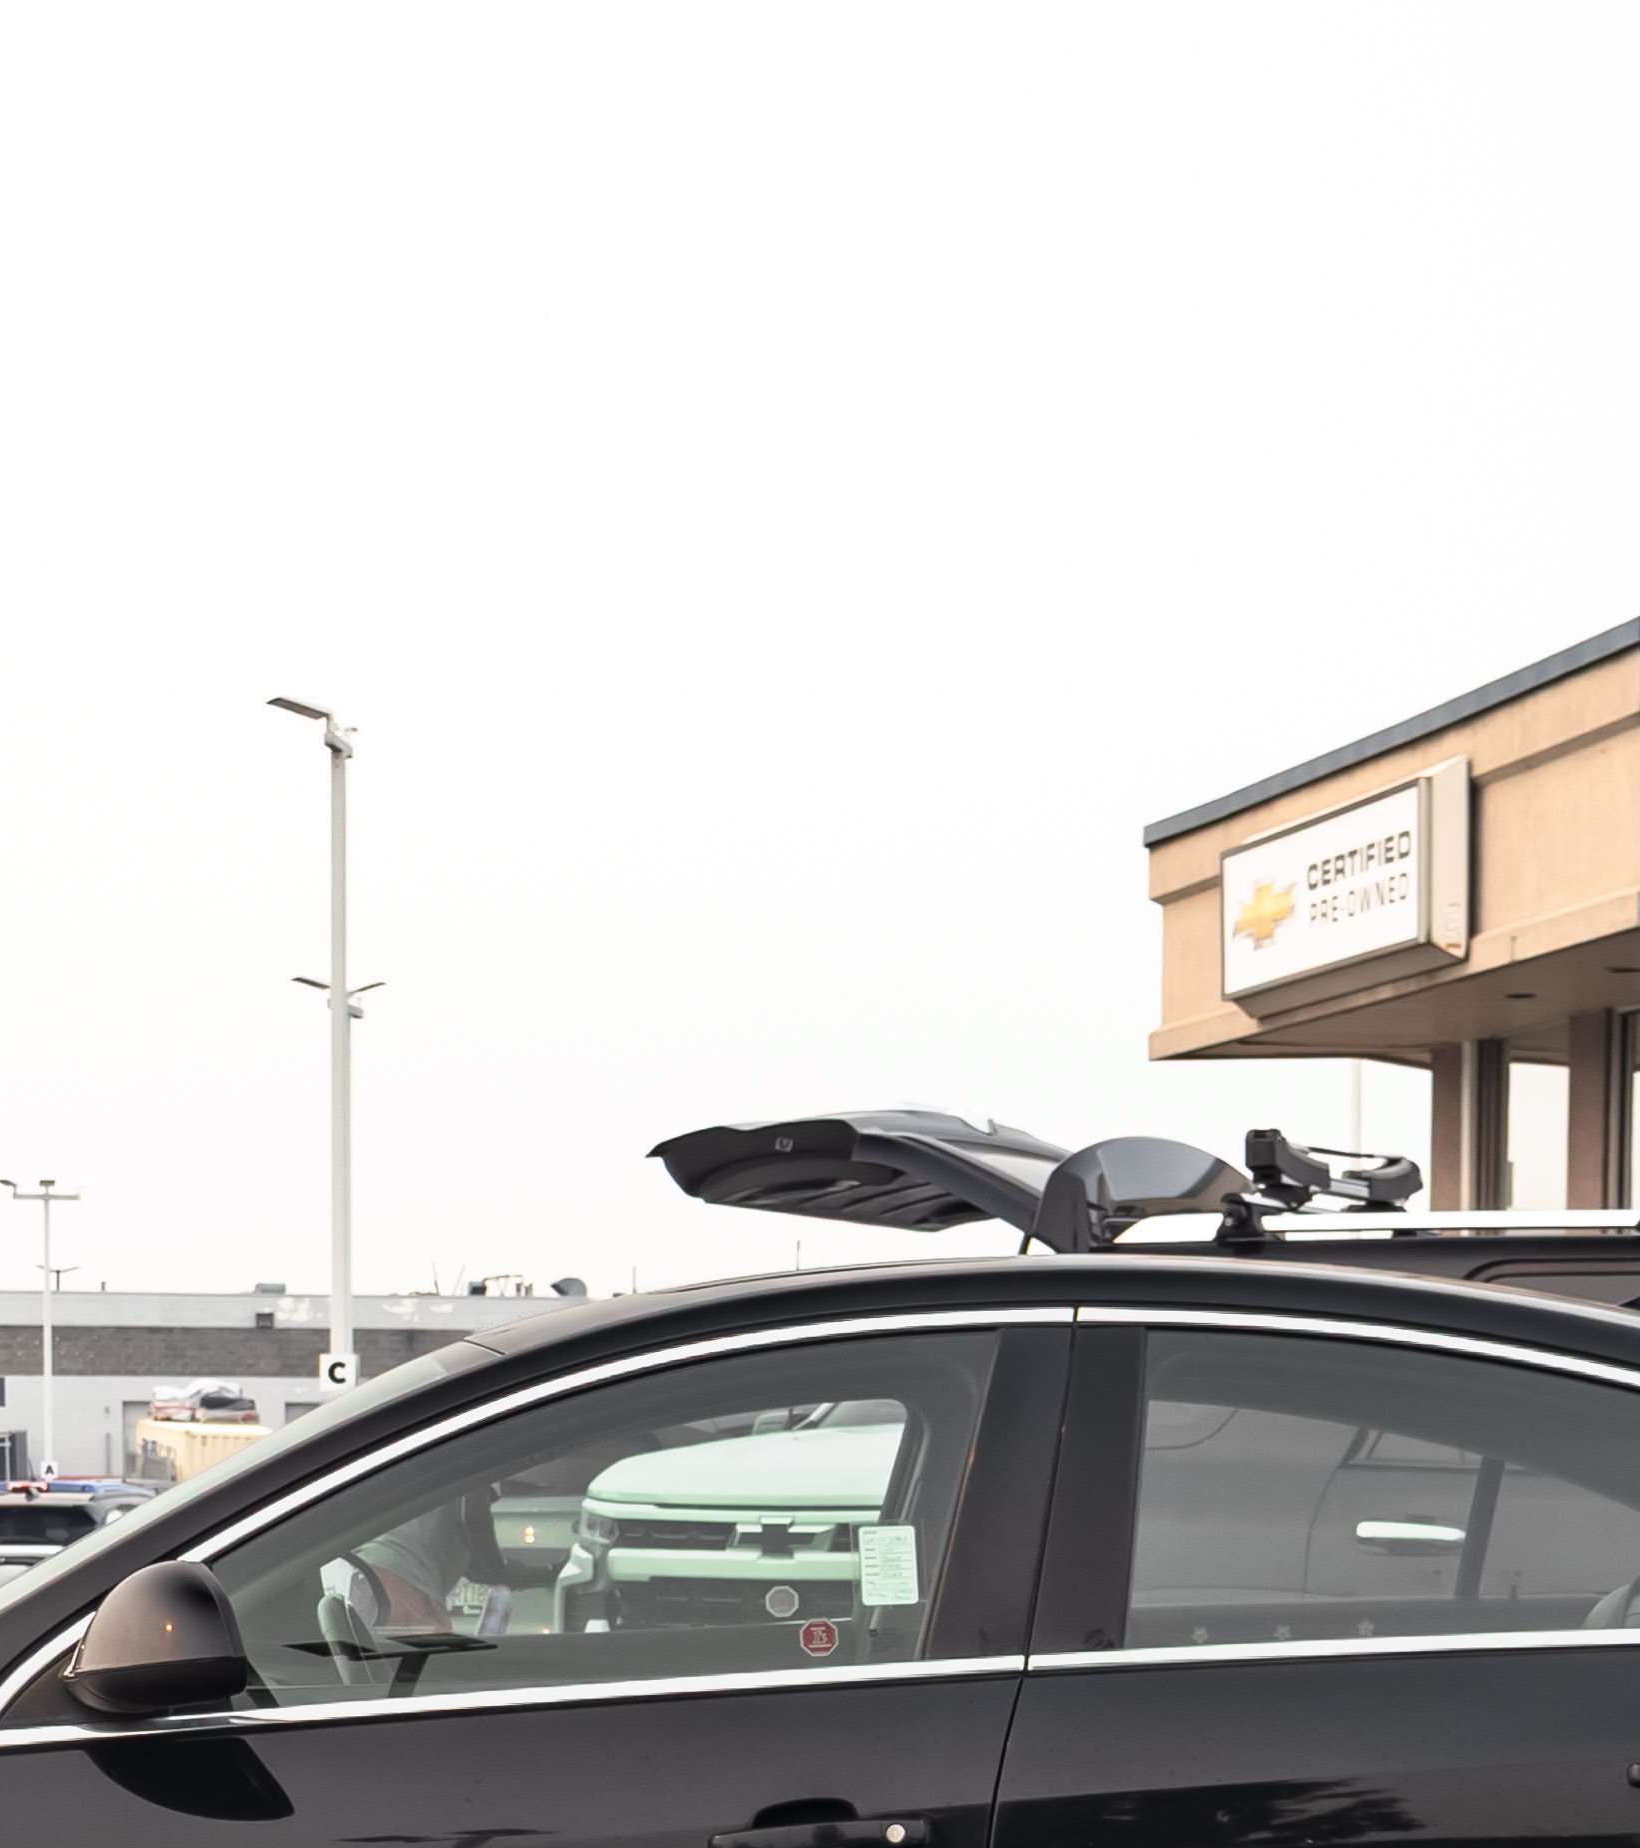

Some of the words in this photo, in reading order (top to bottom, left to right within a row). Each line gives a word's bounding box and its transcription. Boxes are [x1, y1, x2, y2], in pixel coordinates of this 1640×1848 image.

[1306, 830, 1412, 891] CERTIFIED
[1310, 872, 1409, 926] PRE-OWNED
[328, 1361, 346, 1384] C
[45, 1464, 54, 1476] A
